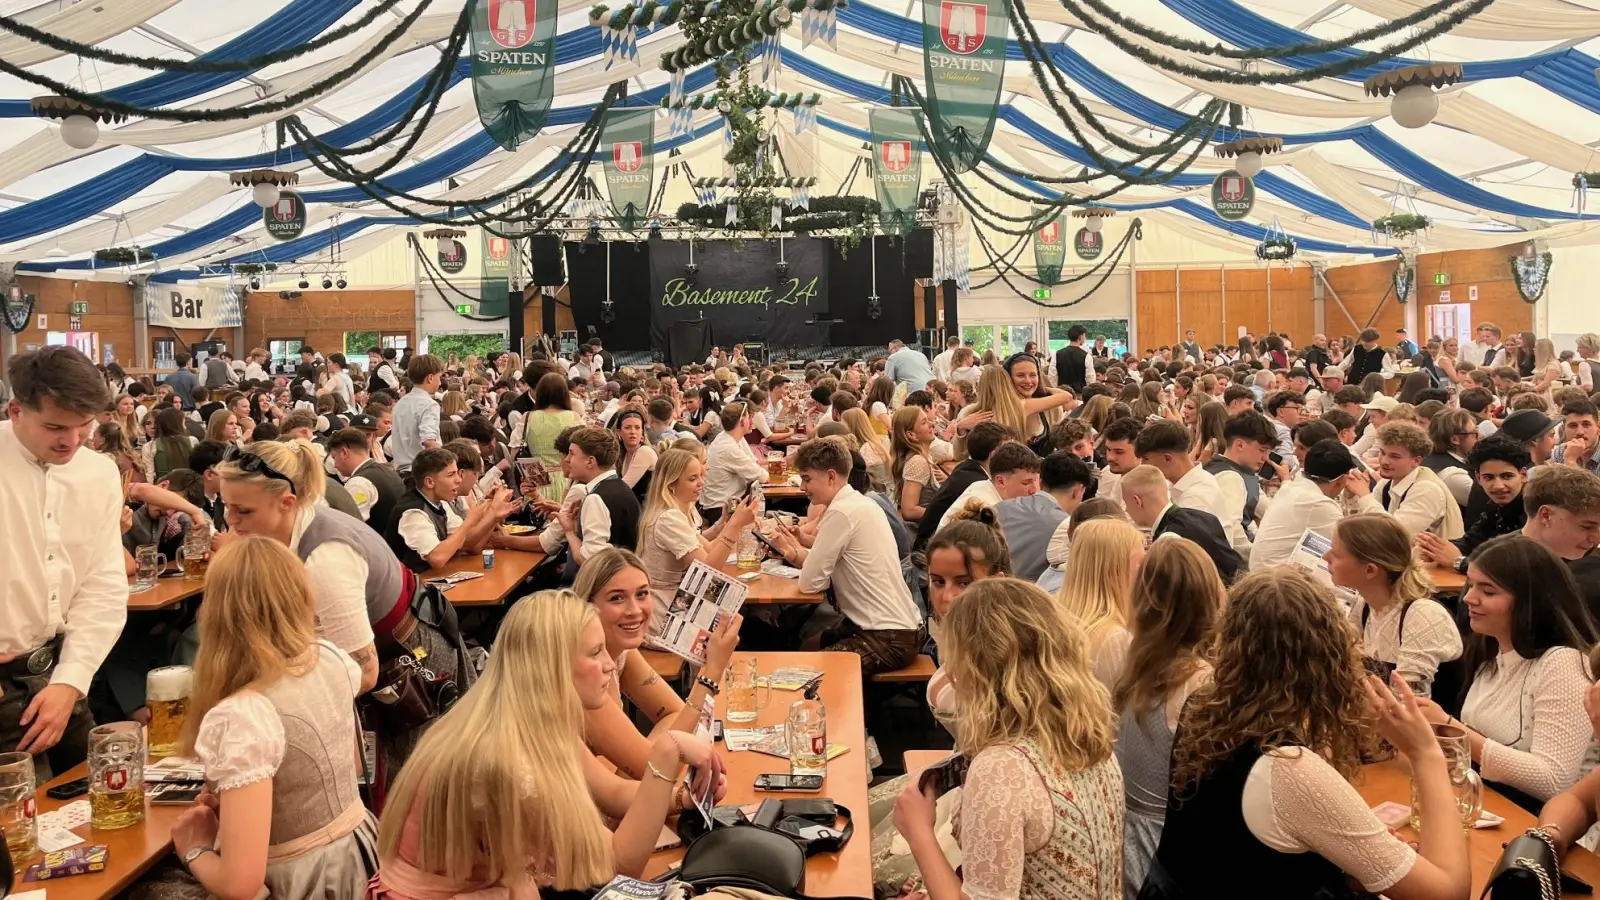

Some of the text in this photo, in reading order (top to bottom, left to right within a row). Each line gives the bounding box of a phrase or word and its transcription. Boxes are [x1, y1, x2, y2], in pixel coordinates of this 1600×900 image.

[518, 32, 526, 41] S
[947, 37, 976, 47] G S
[478, 49, 546, 65] SPATEN
[929, 55, 994, 72] SPATEN
[609, 174, 649, 184] SPATEN
[877, 174, 917, 183] SPATEN
[269, 223, 302, 231] SPATEN
[661, 276, 818, 307] Basement 24
[170, 291, 203, 319] Bar
